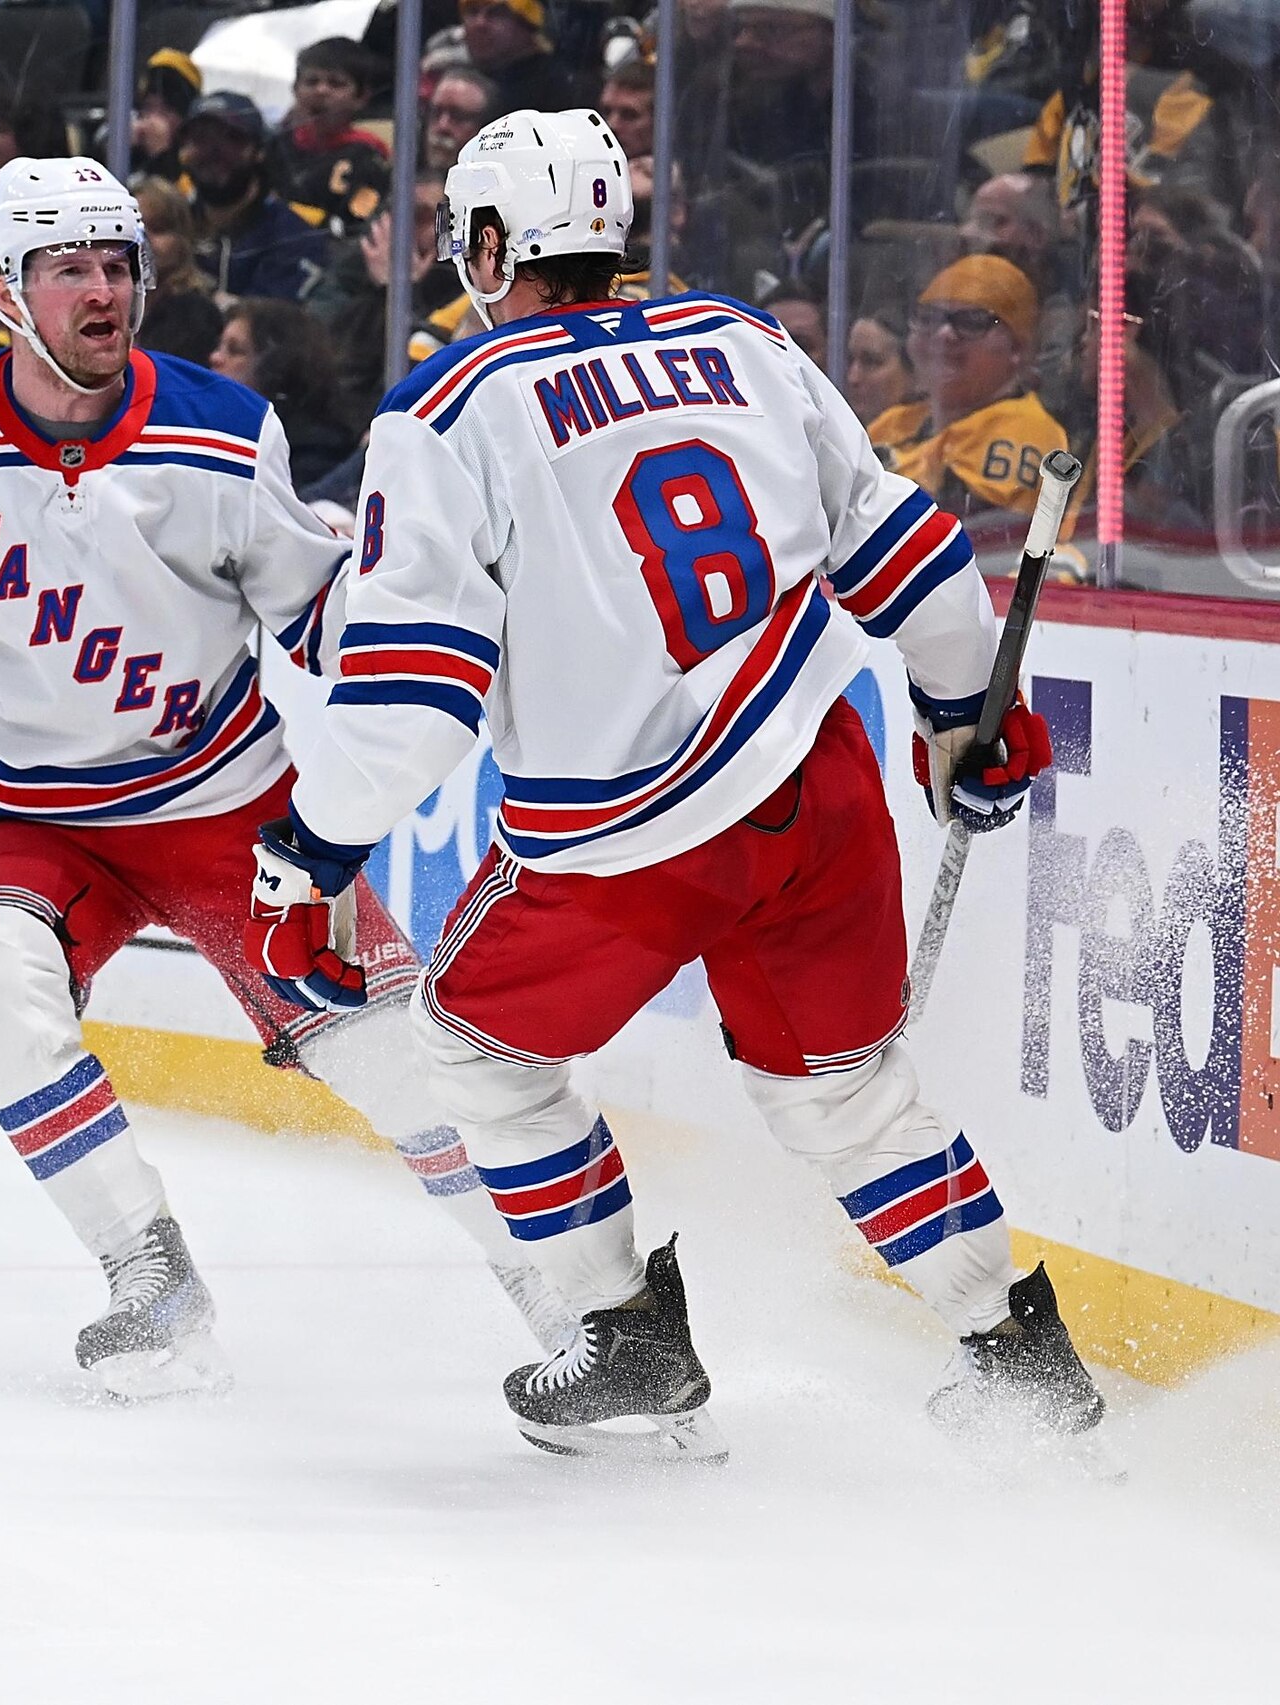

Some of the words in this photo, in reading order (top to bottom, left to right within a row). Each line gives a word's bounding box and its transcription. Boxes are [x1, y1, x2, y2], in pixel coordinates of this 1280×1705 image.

[592, 178, 608, 209] 8
[533, 347, 749, 449] MILLER
[359, 490, 386, 576] 8
[611, 437, 777, 674] 8
